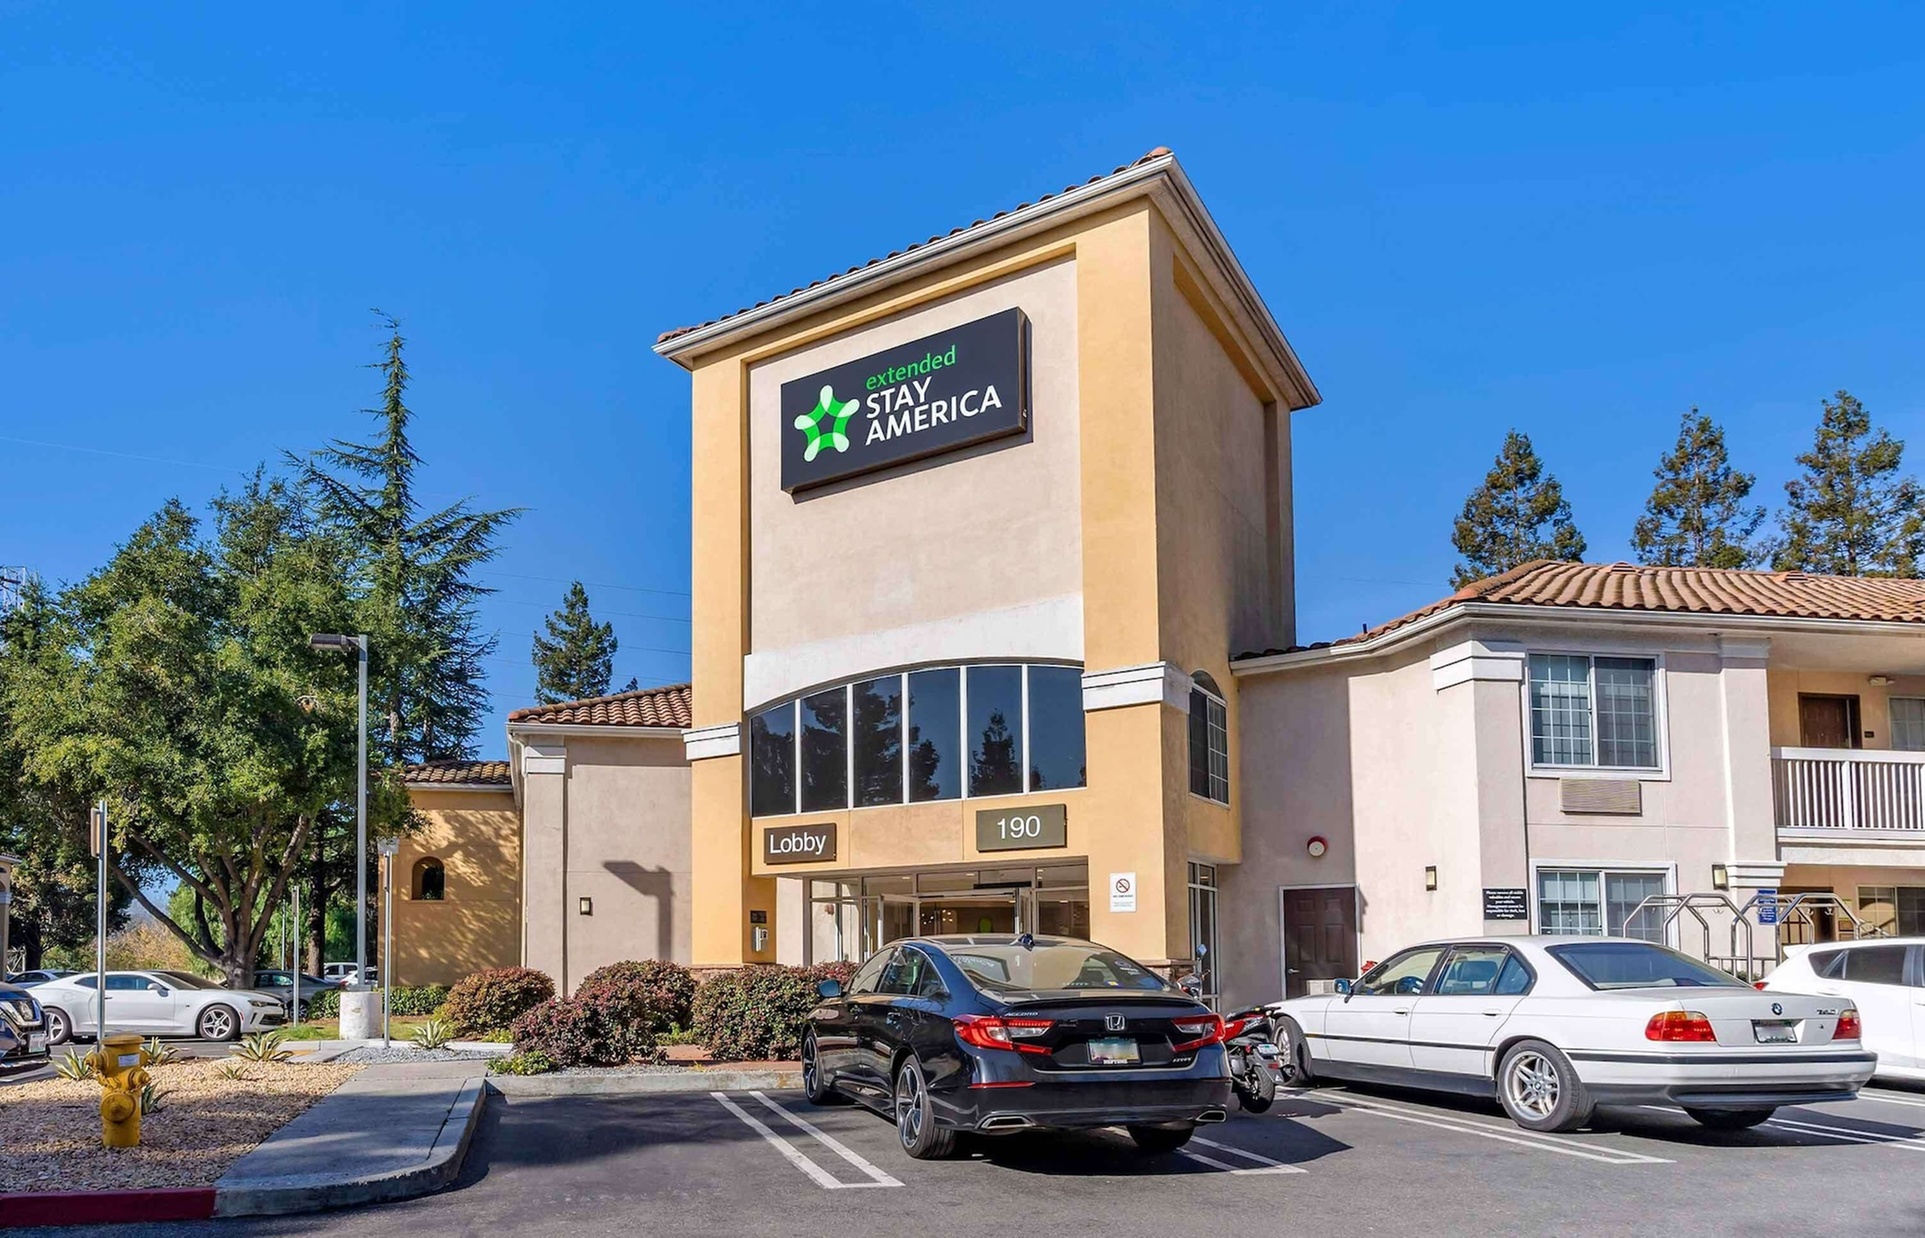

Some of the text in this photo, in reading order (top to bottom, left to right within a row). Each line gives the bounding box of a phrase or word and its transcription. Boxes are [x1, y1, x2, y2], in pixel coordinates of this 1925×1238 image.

[865, 345, 956, 390] extended
[864, 385, 1002, 446] AMERICA
[866, 376, 933, 419] STAY
[769, 832, 827, 855] Lobby
[996, 815, 1041, 839] 190
